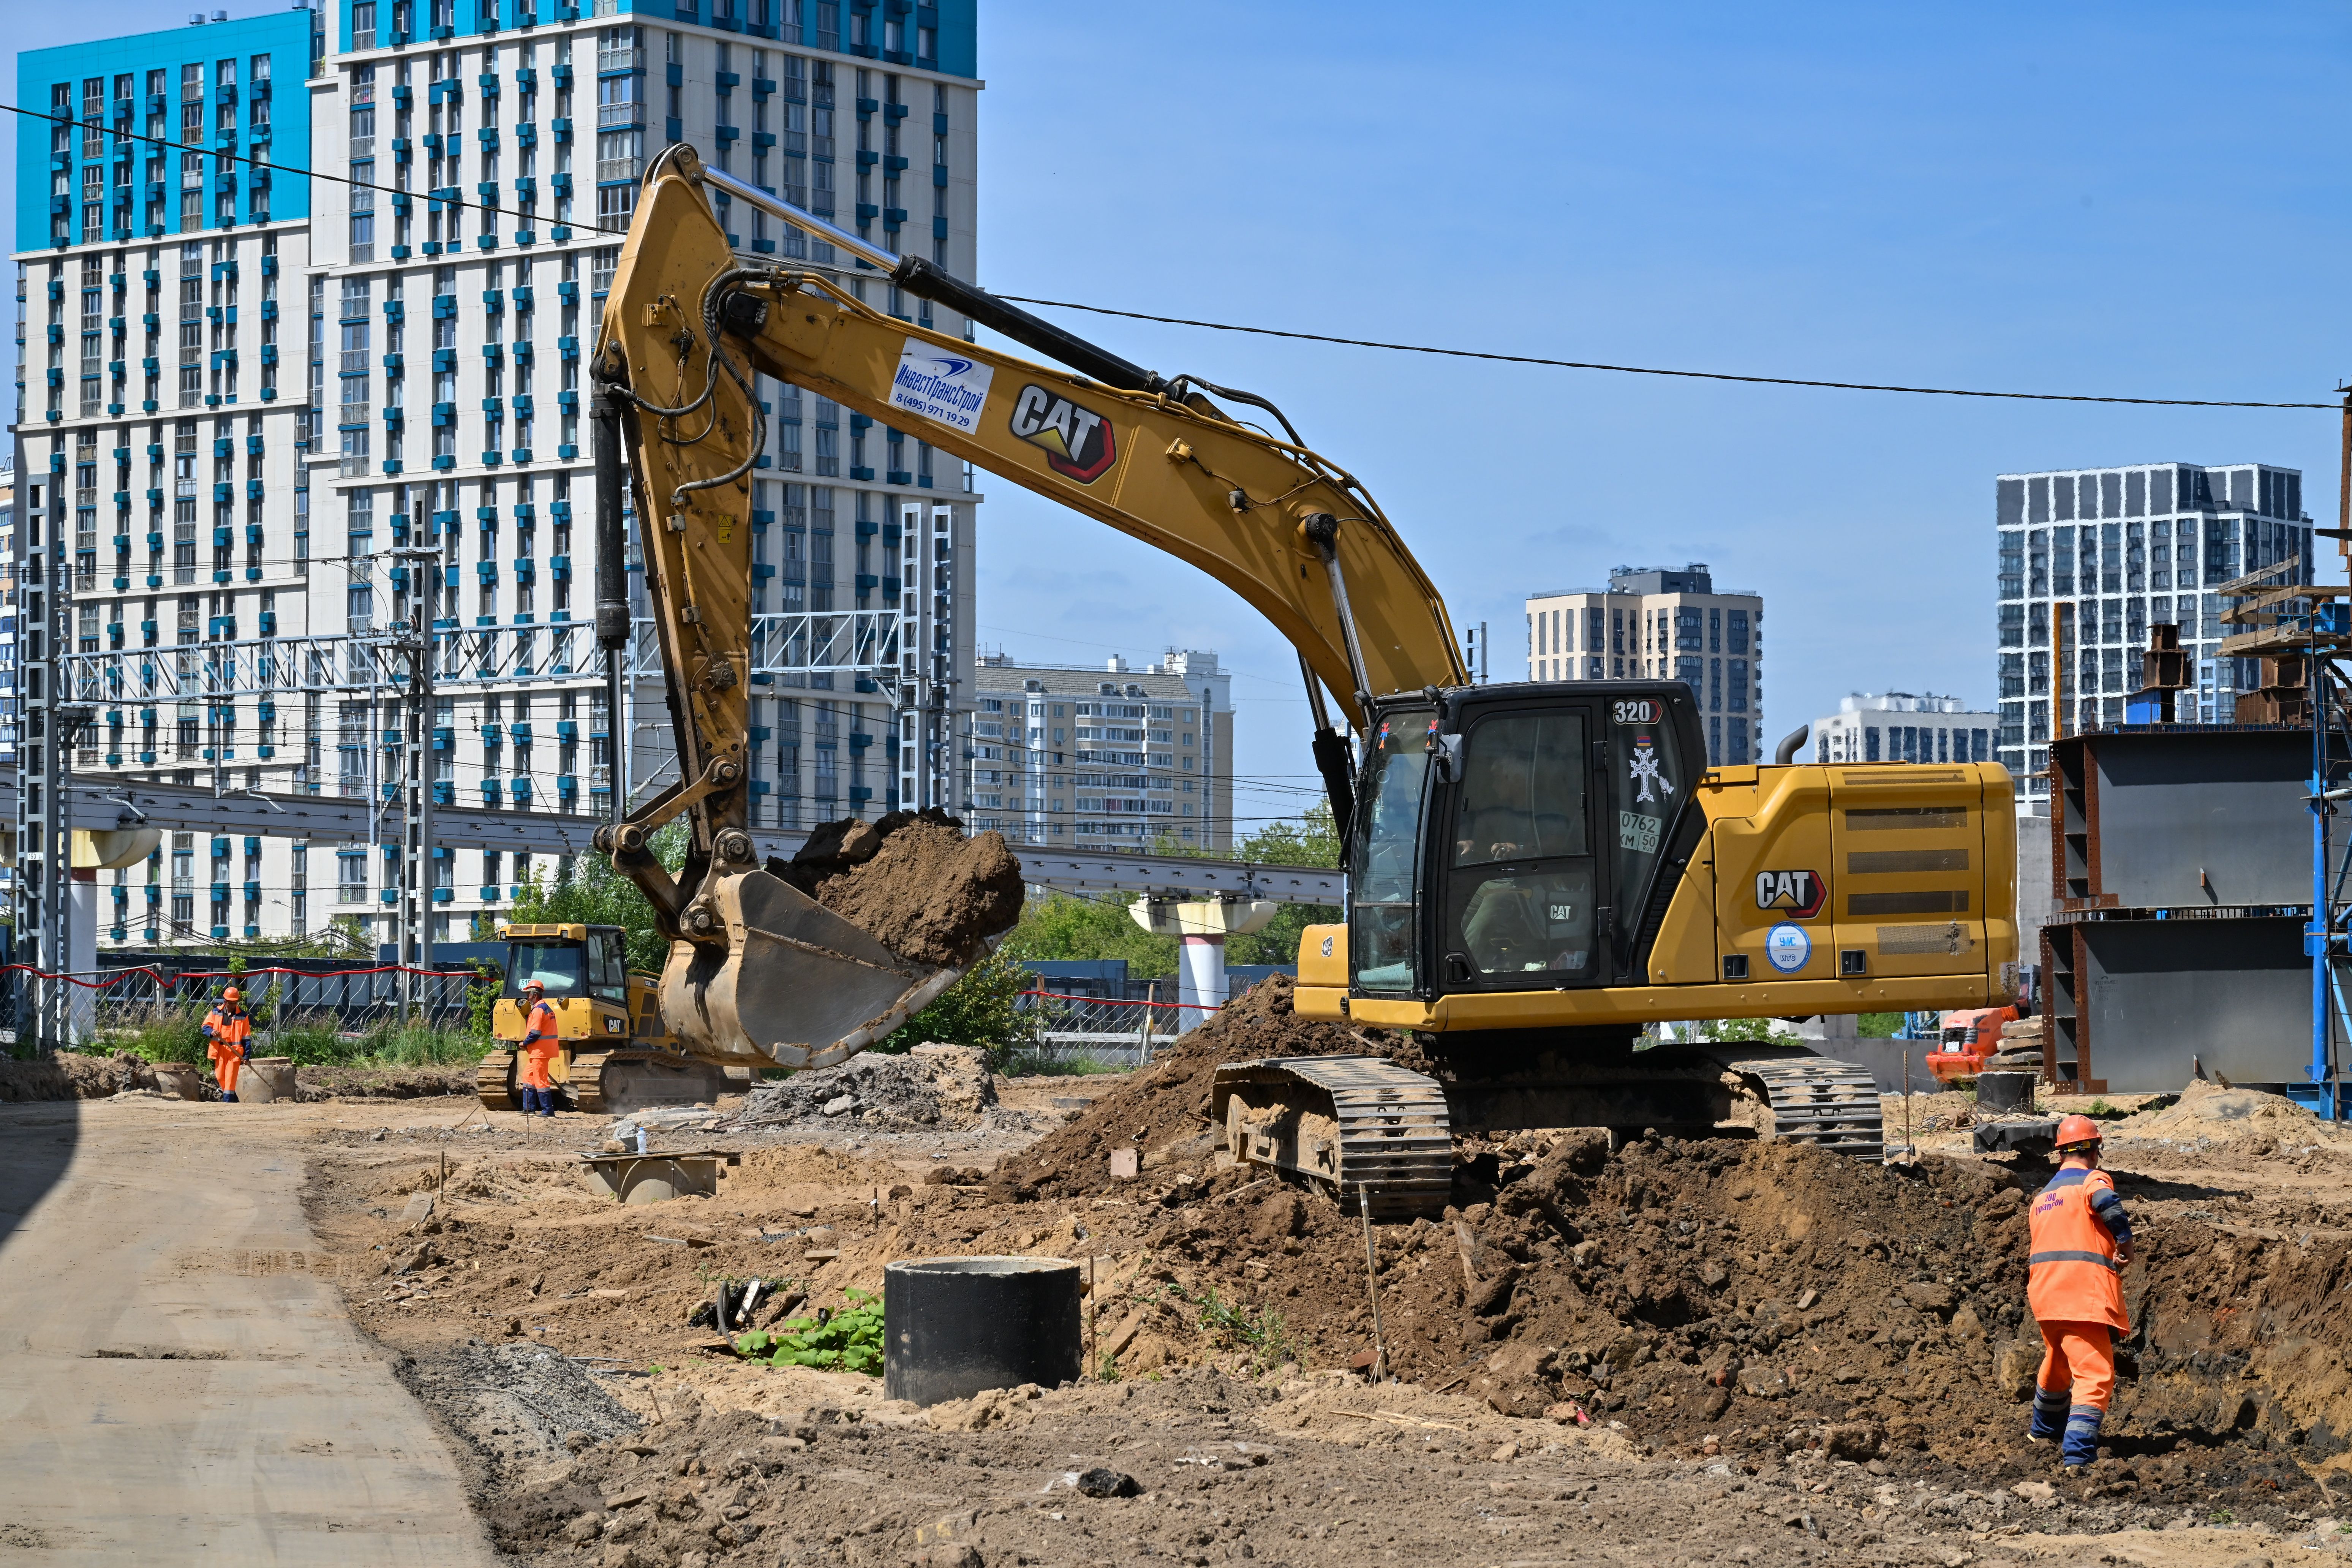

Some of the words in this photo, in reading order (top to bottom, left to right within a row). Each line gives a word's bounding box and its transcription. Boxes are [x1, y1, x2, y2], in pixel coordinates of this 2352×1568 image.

[895, 364, 983, 413] ИнвестТрансСтрой
[896, 393, 903, 402] 8
[904, 395, 926, 412] (495)
[928, 405, 944, 417] 971
[947, 411, 957, 422] 19
[957, 416, 970, 426] 29
[1012, 386, 1100, 462] CAT
[1615, 701, 1650, 722] 320
[1622, 813, 1656, 833] 0762
[1642, 834, 1656, 847] 50
[1757, 872, 1809, 908] CAT
[1550, 905, 1571, 920] CAT
[609, 1019, 621, 1032] CAT
